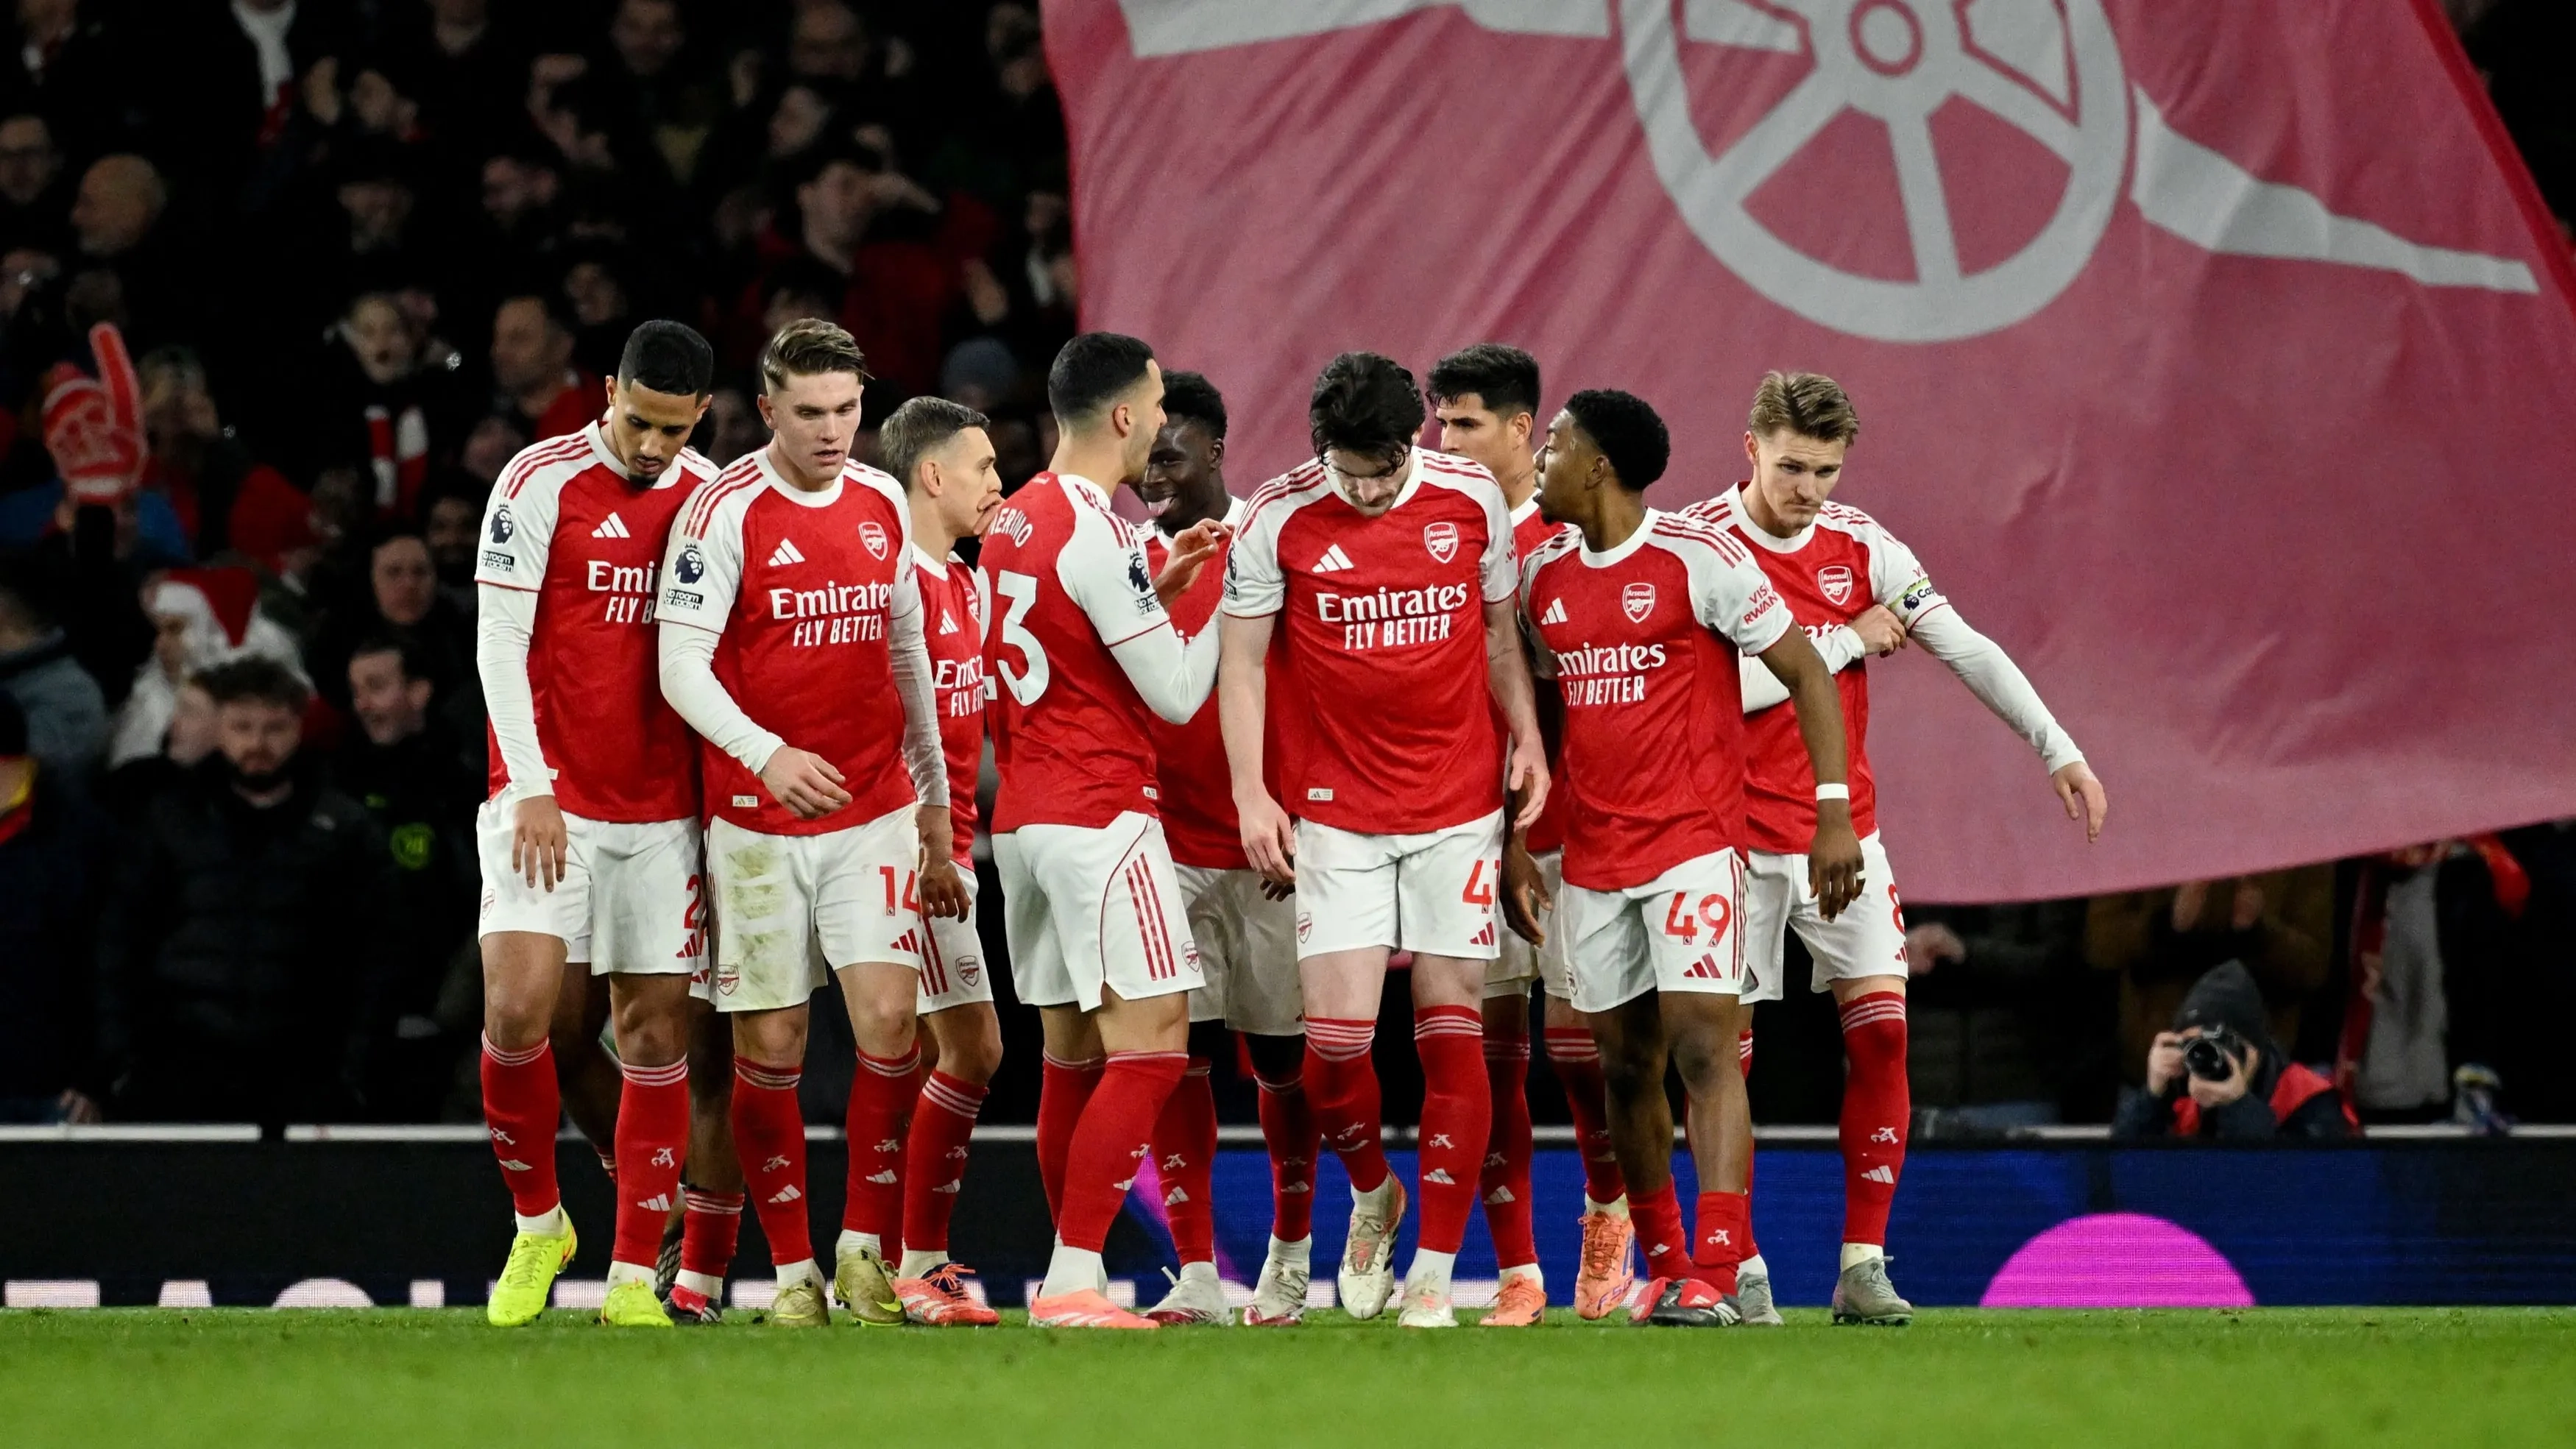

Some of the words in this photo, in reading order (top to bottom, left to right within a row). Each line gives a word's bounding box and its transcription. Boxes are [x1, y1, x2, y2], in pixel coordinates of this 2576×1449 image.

[605, 596, 640, 623] FLY
[676, 591, 699, 603] room
[1315, 582, 1468, 623] Emirates
[793, 620, 825, 647] FLY
[829, 614, 882, 645] BETTER
[1344, 622, 1376, 651] FLY
[1383, 614, 1450, 648] BETTER
[1585, 675, 1645, 706] BETTER
[880, 865, 923, 922] 14
[1665, 891, 1730, 947] 49
